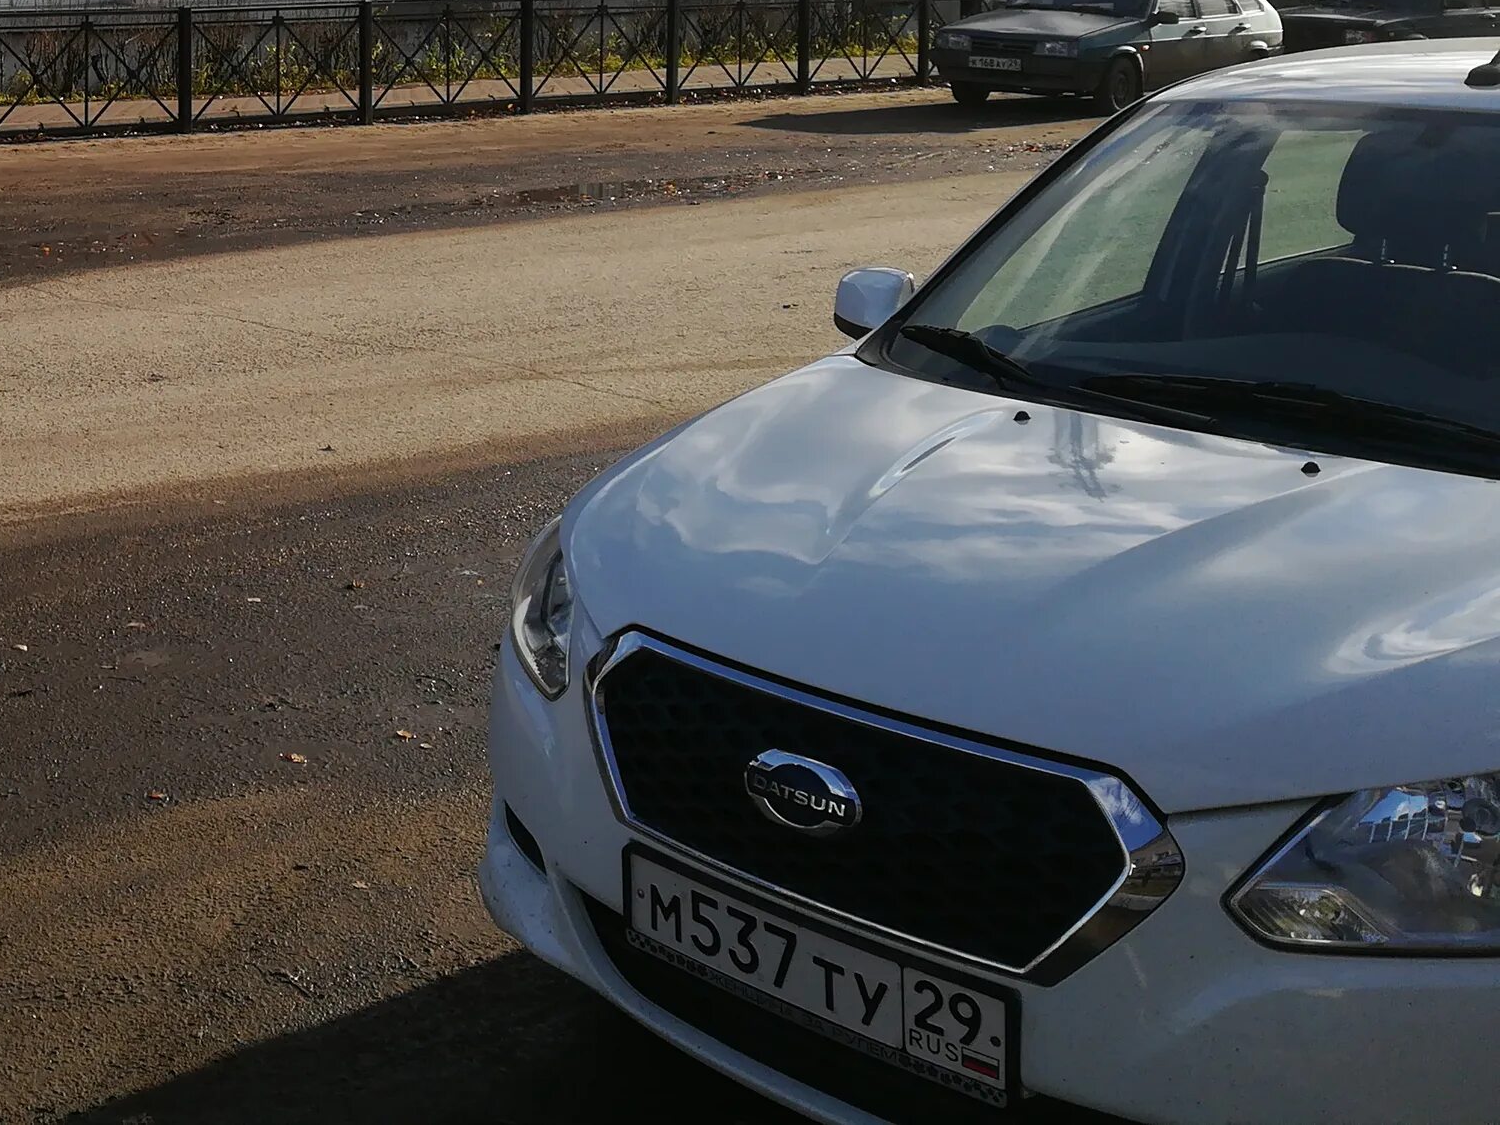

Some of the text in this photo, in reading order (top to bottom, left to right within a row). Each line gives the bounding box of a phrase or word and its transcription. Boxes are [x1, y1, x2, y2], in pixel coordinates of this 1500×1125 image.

[752, 773, 846, 818] DATSUN
[914, 980, 982, 1047] 29
[909, 1029, 959, 1062] RUS
